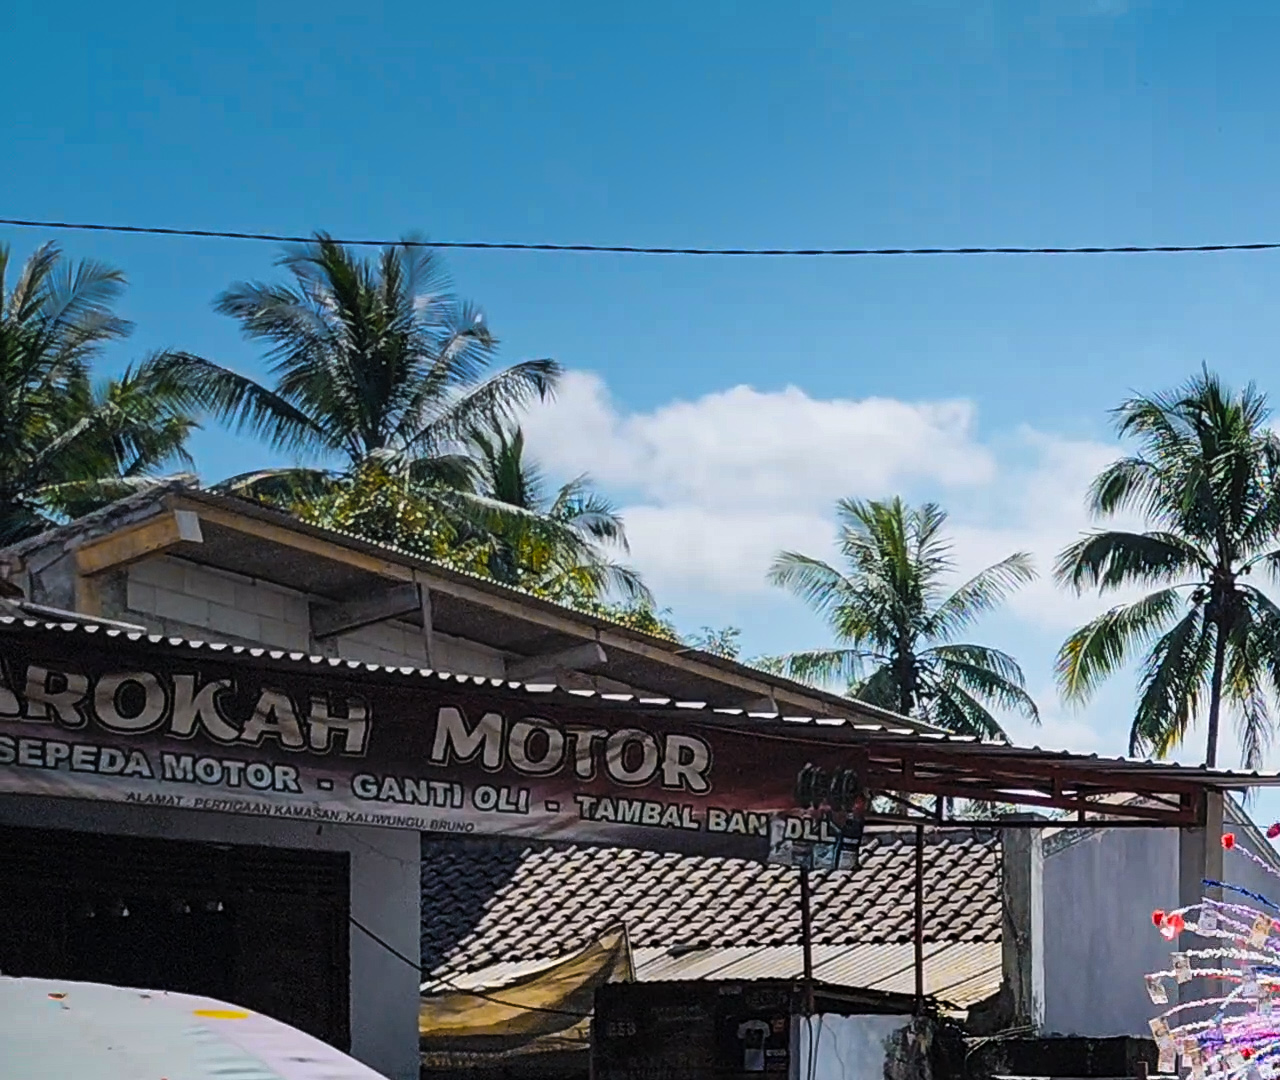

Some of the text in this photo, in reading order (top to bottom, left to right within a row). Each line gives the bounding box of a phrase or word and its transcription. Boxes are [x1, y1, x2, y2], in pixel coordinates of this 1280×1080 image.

[0, 736, 153, 778] SEPEDA
[162, 753, 303, 793] MOTOR
[352, 773, 464, 809] GANTI
[473, 783, 530, 814] OLI
[574, 795, 700, 831] TAMBAL
[707, 808, 769, 837] BAN
[784, 816, 837, 843] DLL
[429, 705, 712, 794] MOTOR
[193, 797, 272, 814] PERTIGAAN
[429, 819, 475, 833] BRUNO
